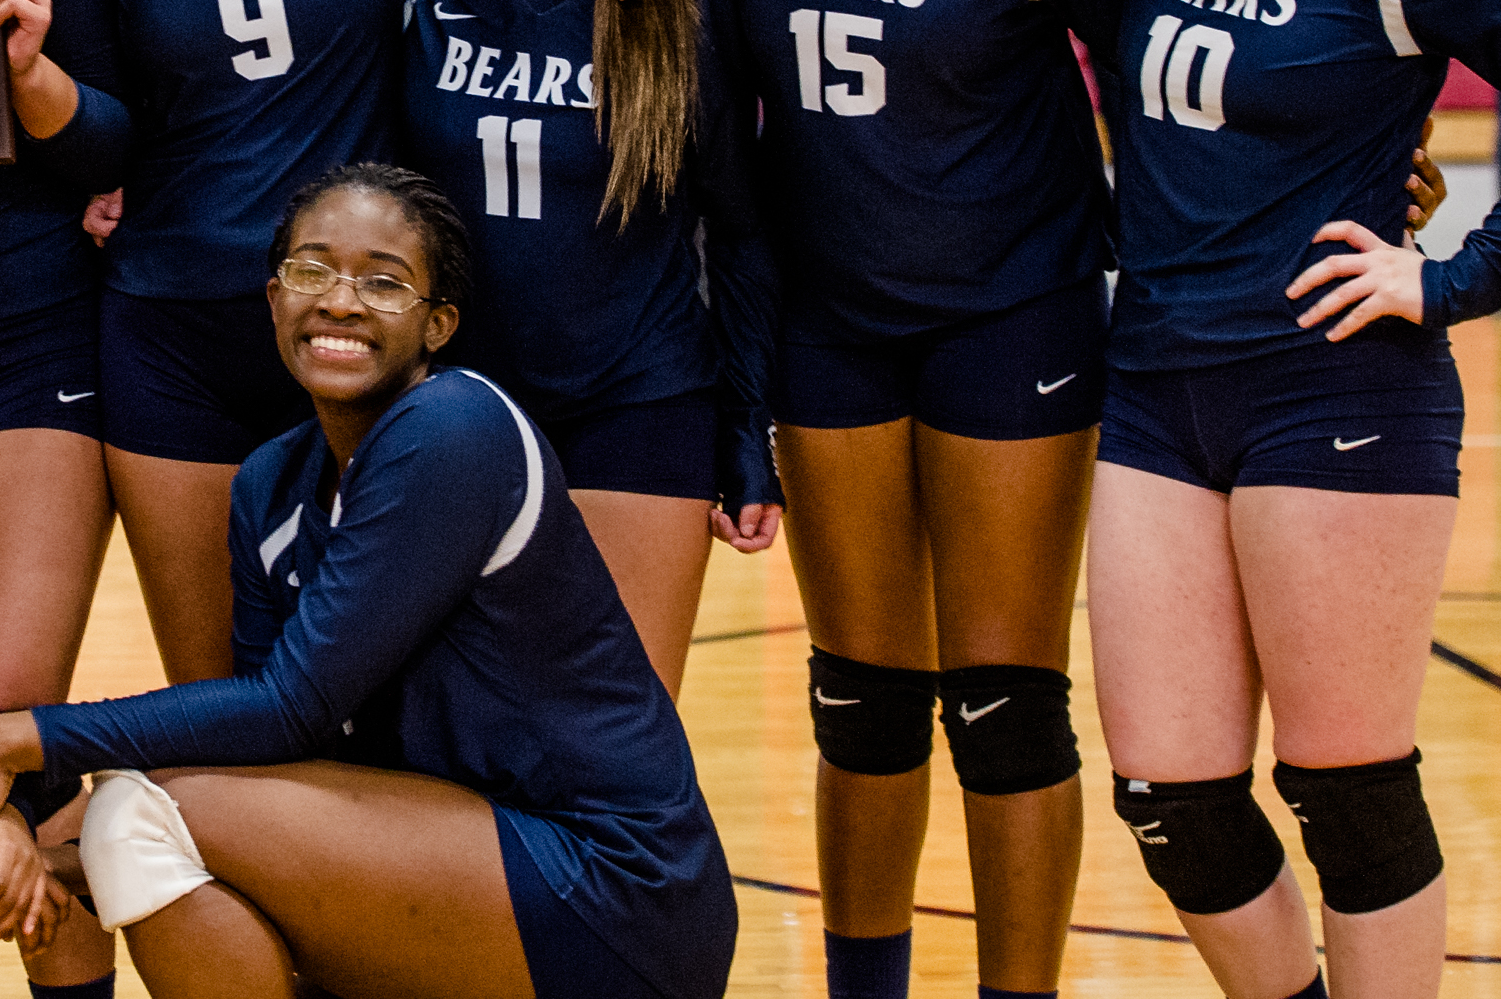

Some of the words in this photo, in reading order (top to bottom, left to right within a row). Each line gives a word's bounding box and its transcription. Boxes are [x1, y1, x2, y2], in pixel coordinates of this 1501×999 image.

[436, 36, 600, 109] BEARS
[789, 9, 887, 117] 15
[1140, 14, 1236, 132] 10
[476, 115, 542, 219] 11
